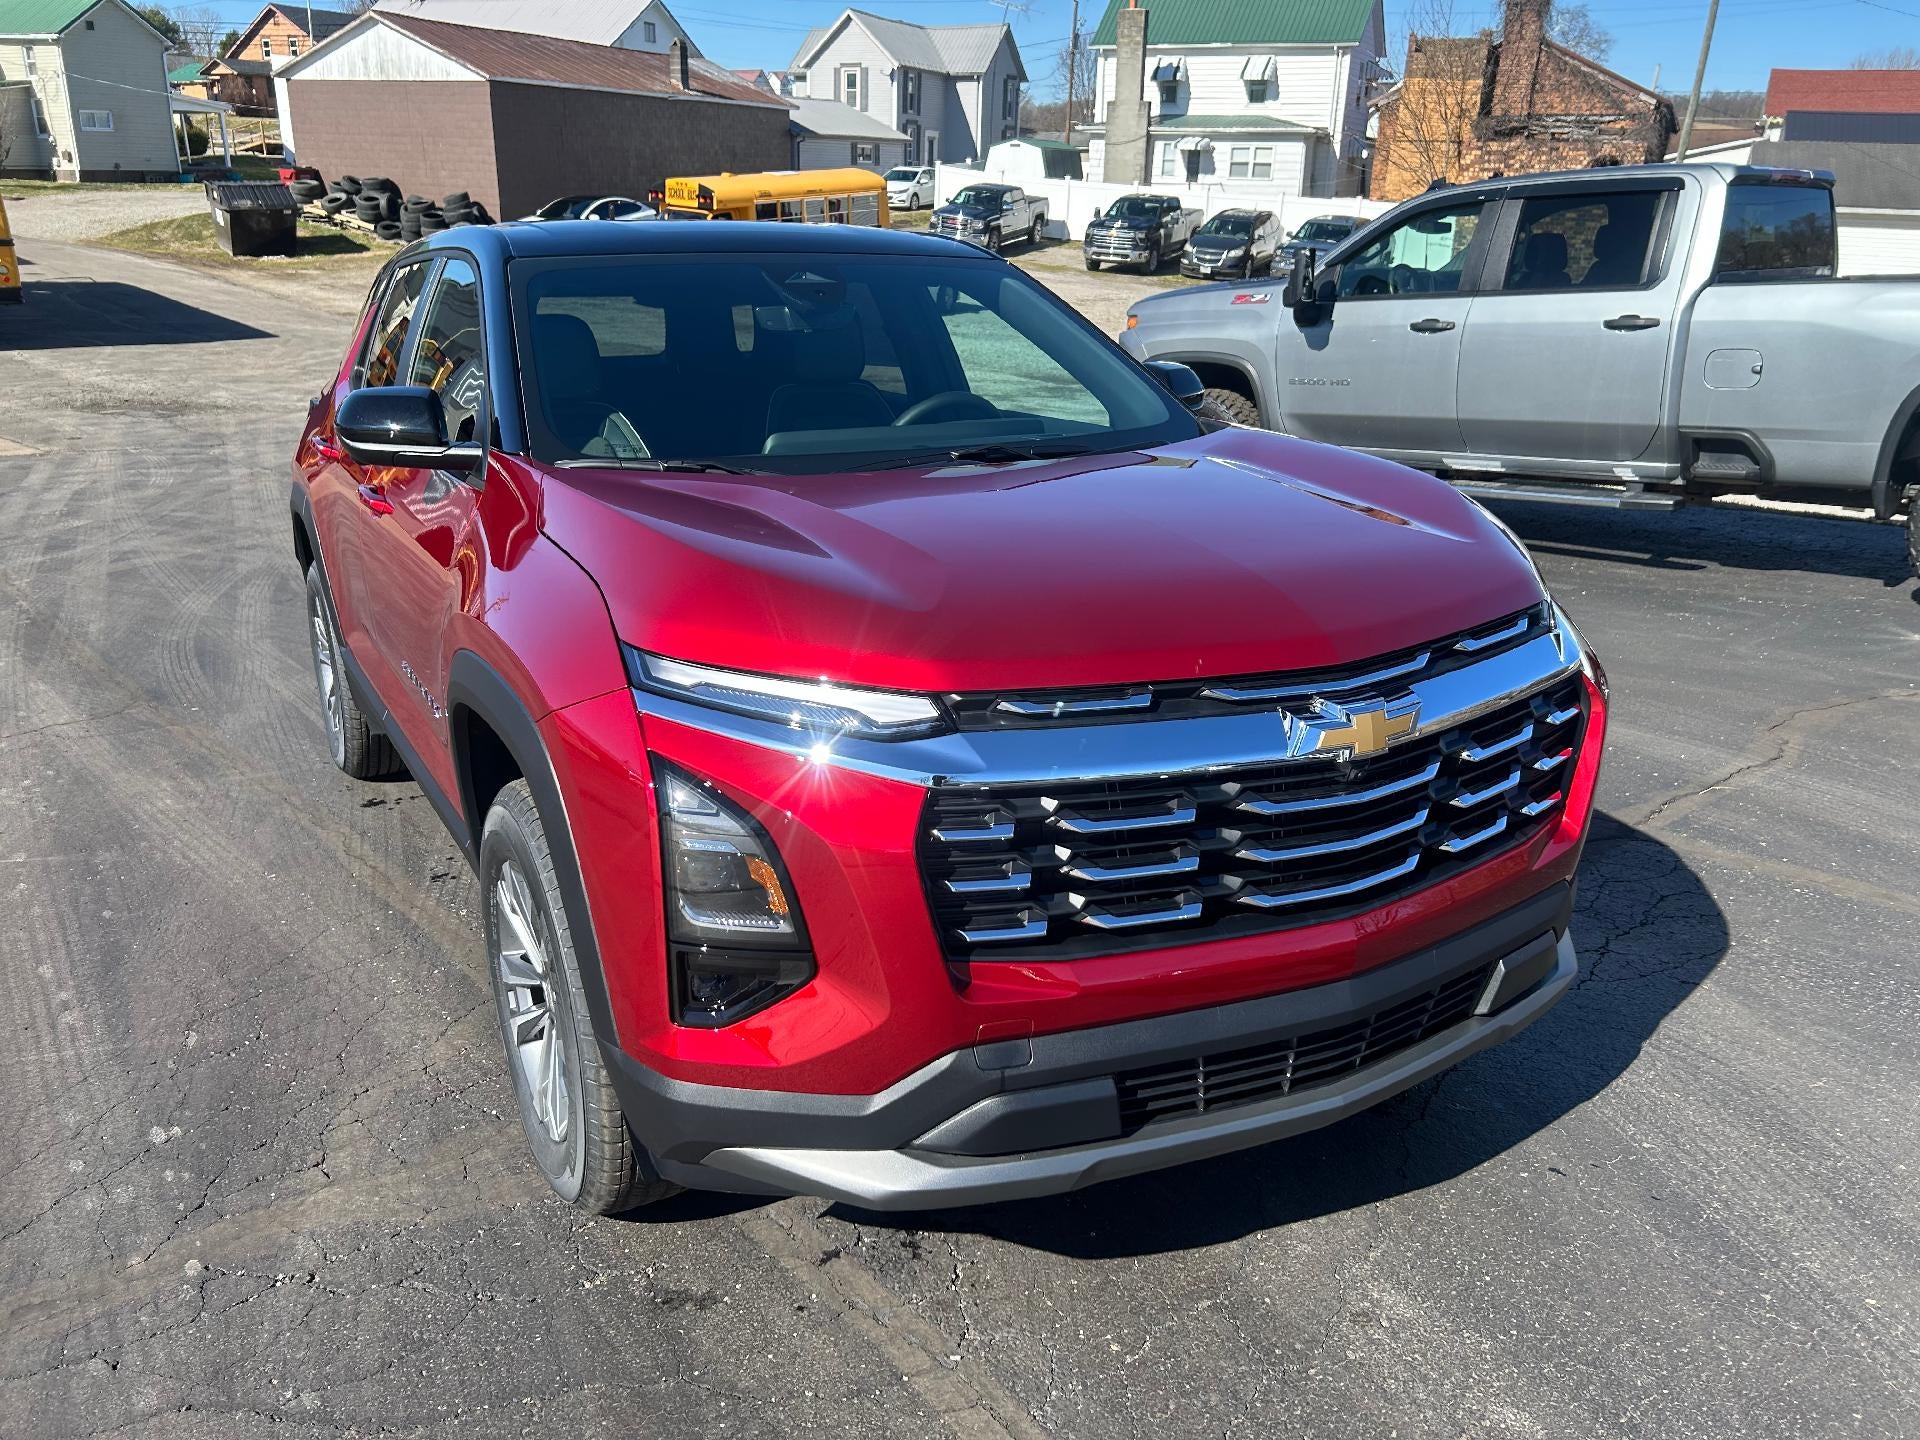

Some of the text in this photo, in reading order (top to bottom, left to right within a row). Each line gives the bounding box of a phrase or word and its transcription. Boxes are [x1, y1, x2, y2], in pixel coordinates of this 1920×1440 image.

[668, 187, 698, 201] SCHOOL BUS
[1231, 293, 1273, 304] Z71
[1329, 378, 1351, 387] HD
